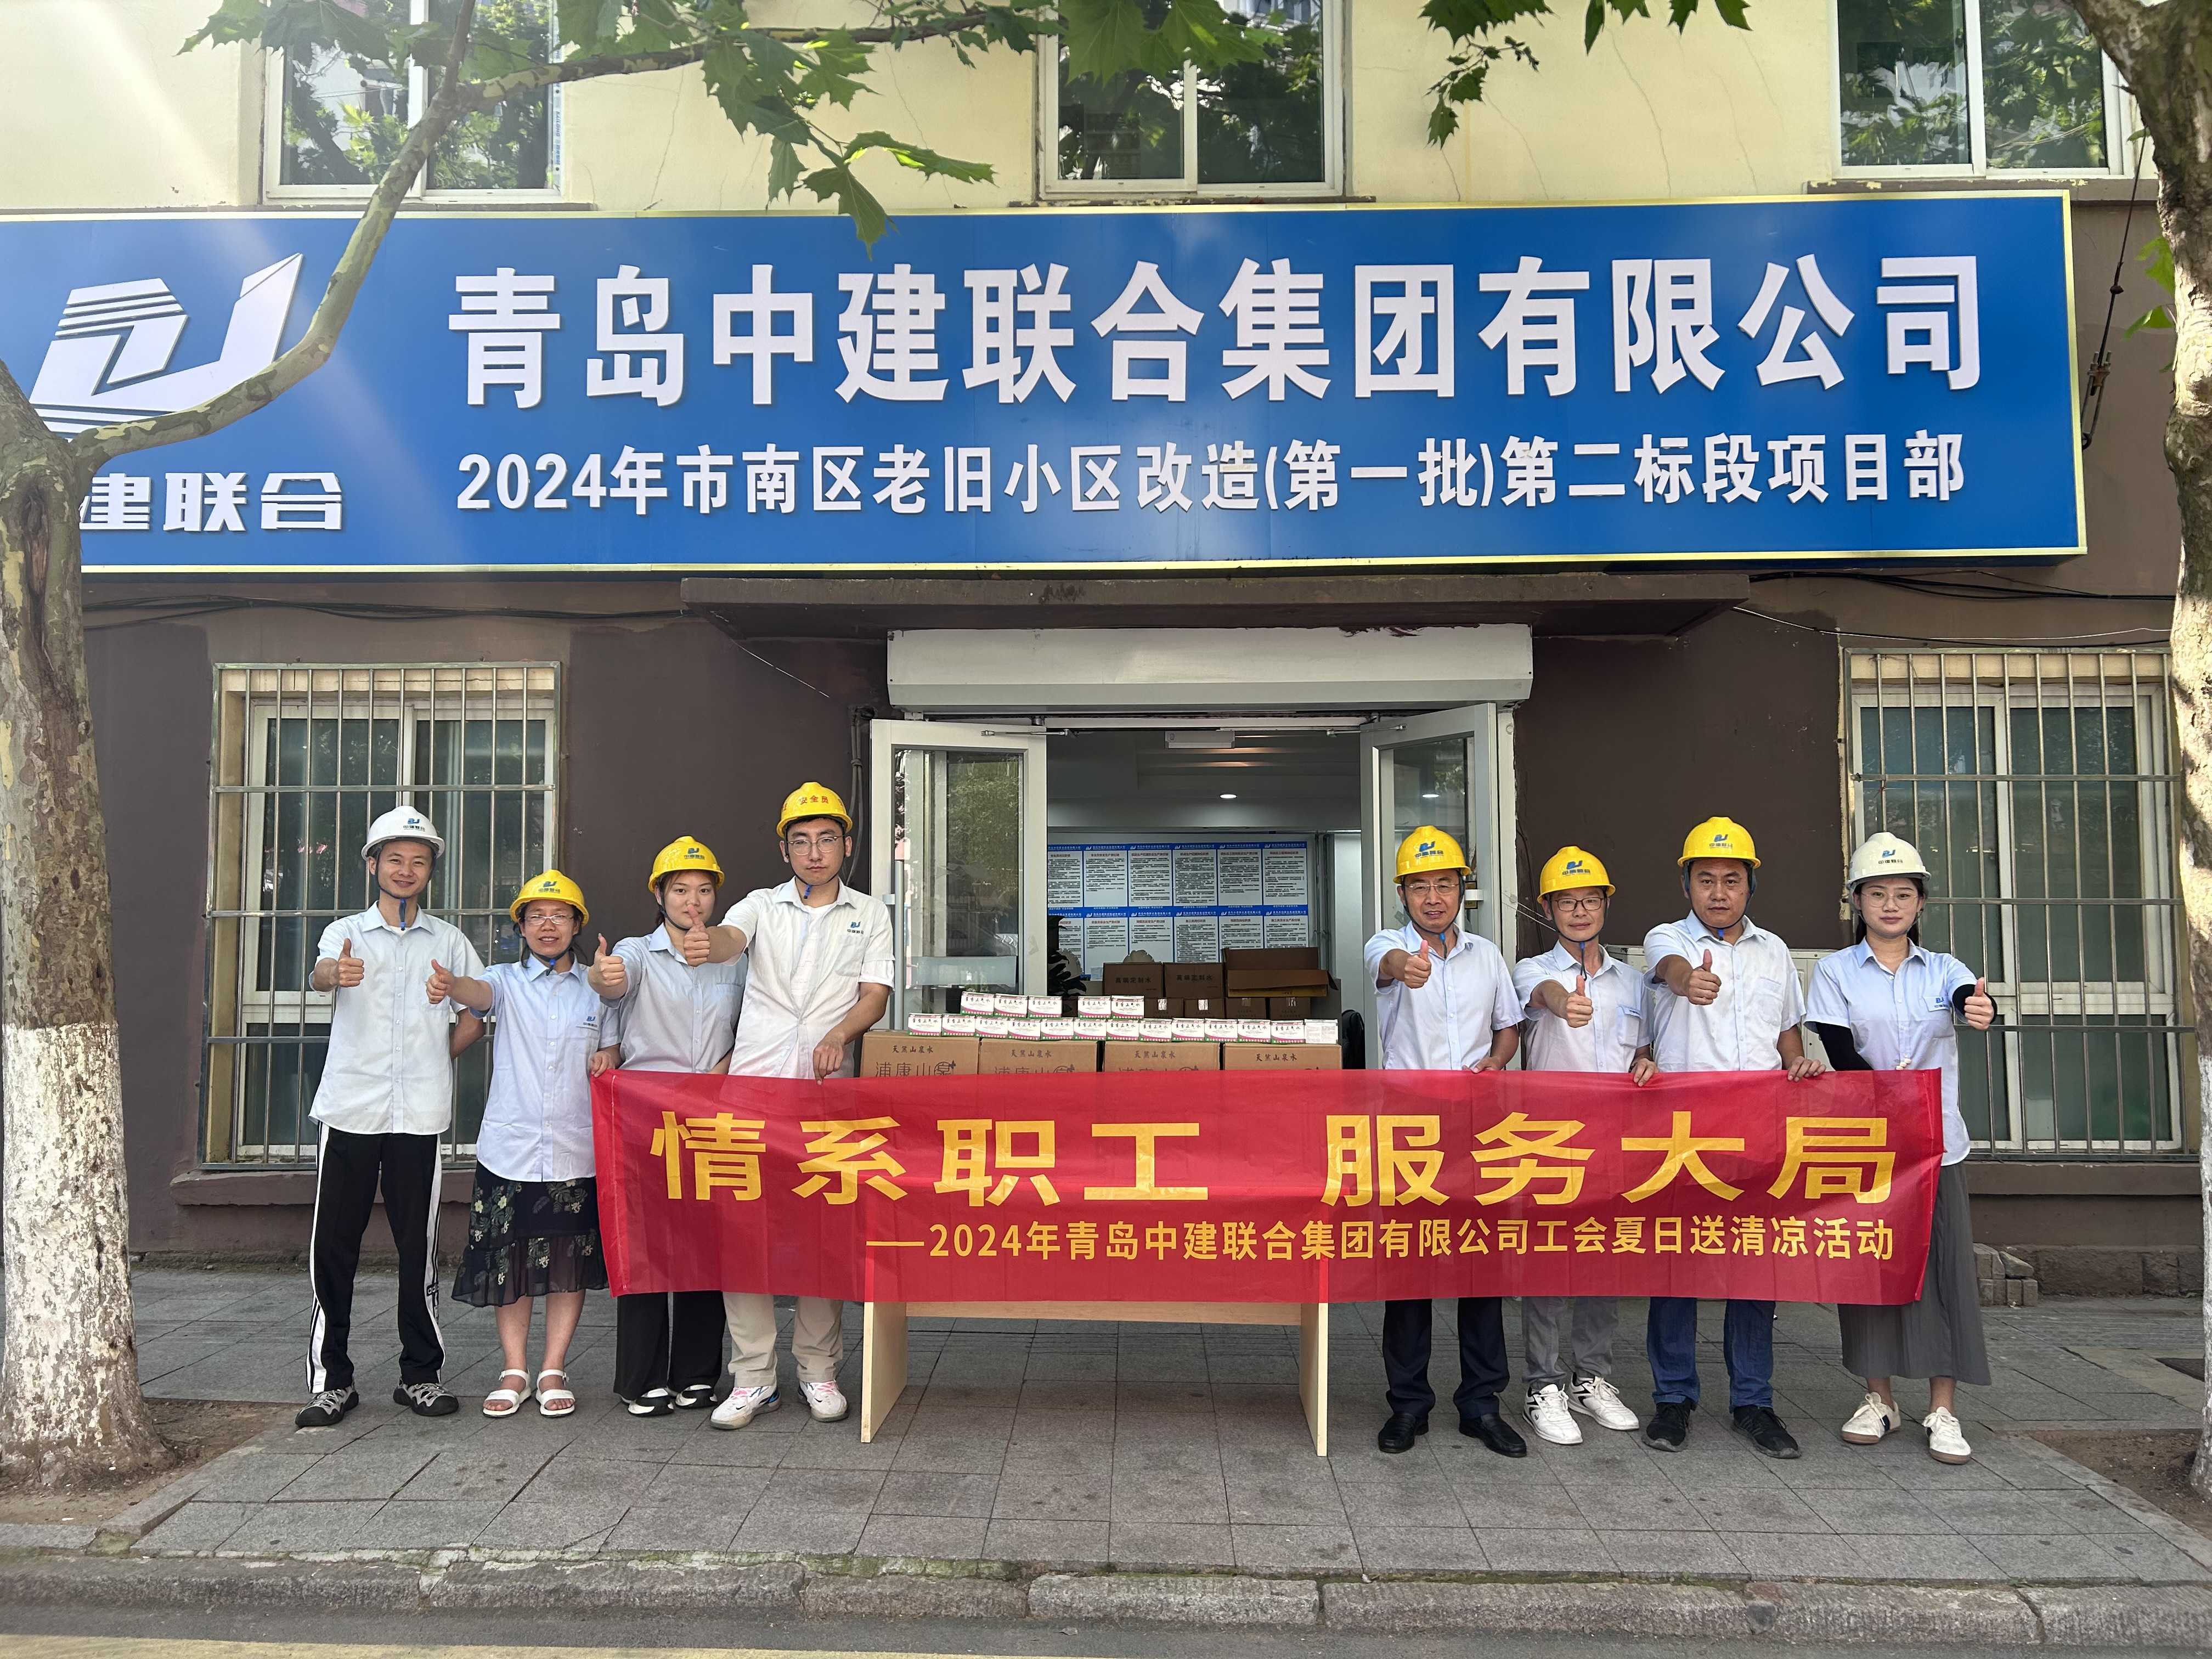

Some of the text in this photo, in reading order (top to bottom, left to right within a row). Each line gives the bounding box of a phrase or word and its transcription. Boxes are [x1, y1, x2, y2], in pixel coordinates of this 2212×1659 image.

[449, 255, 1979, 408] 青岛中建联合集团有限公司
[458, 431, 1963, 515] 2024年市南区老旧小区改造(第一批)第二标段项目部
[651, 1111, 1896, 1207] 情系职工 服务大局
